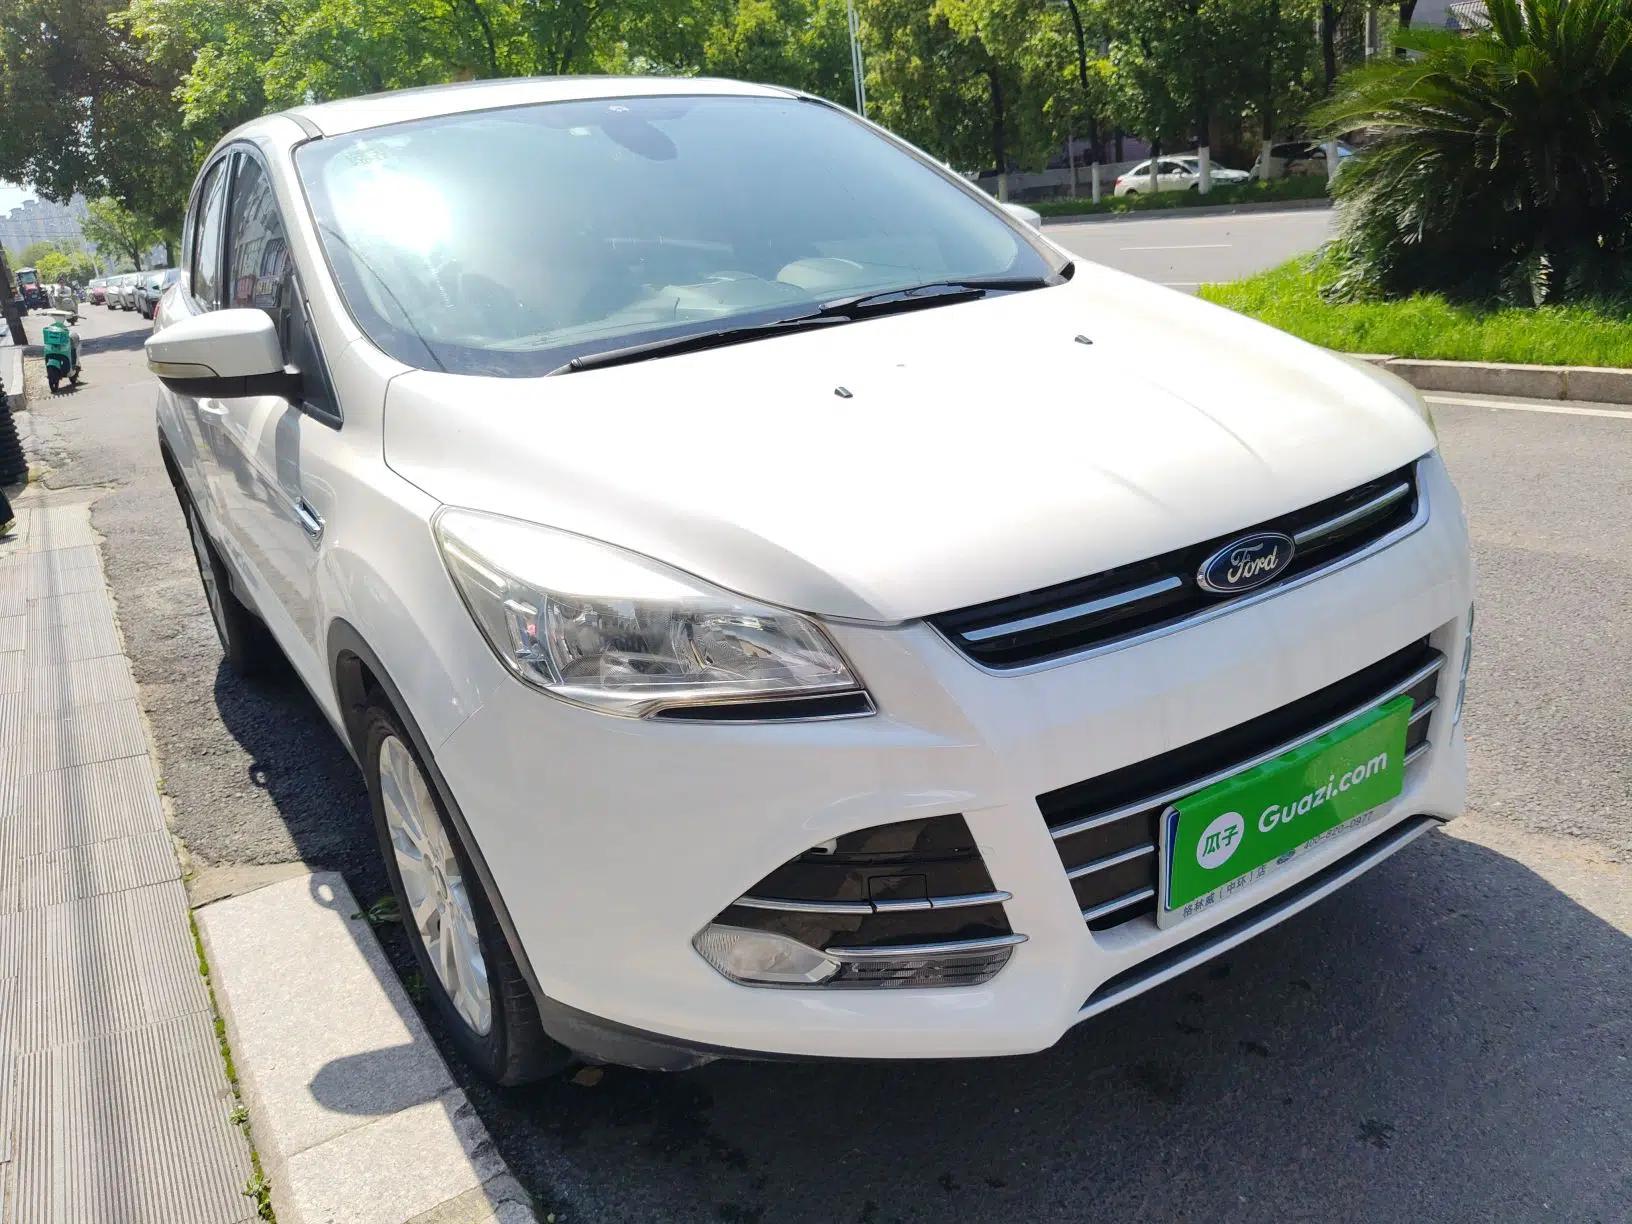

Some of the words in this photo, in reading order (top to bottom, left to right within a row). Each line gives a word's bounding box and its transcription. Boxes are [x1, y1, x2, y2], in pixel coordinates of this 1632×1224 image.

[1227, 542, 1279, 583] Ford
[1258, 752, 1388, 833] Guazi.com
[1202, 823, 1239, 858] 瓜子
